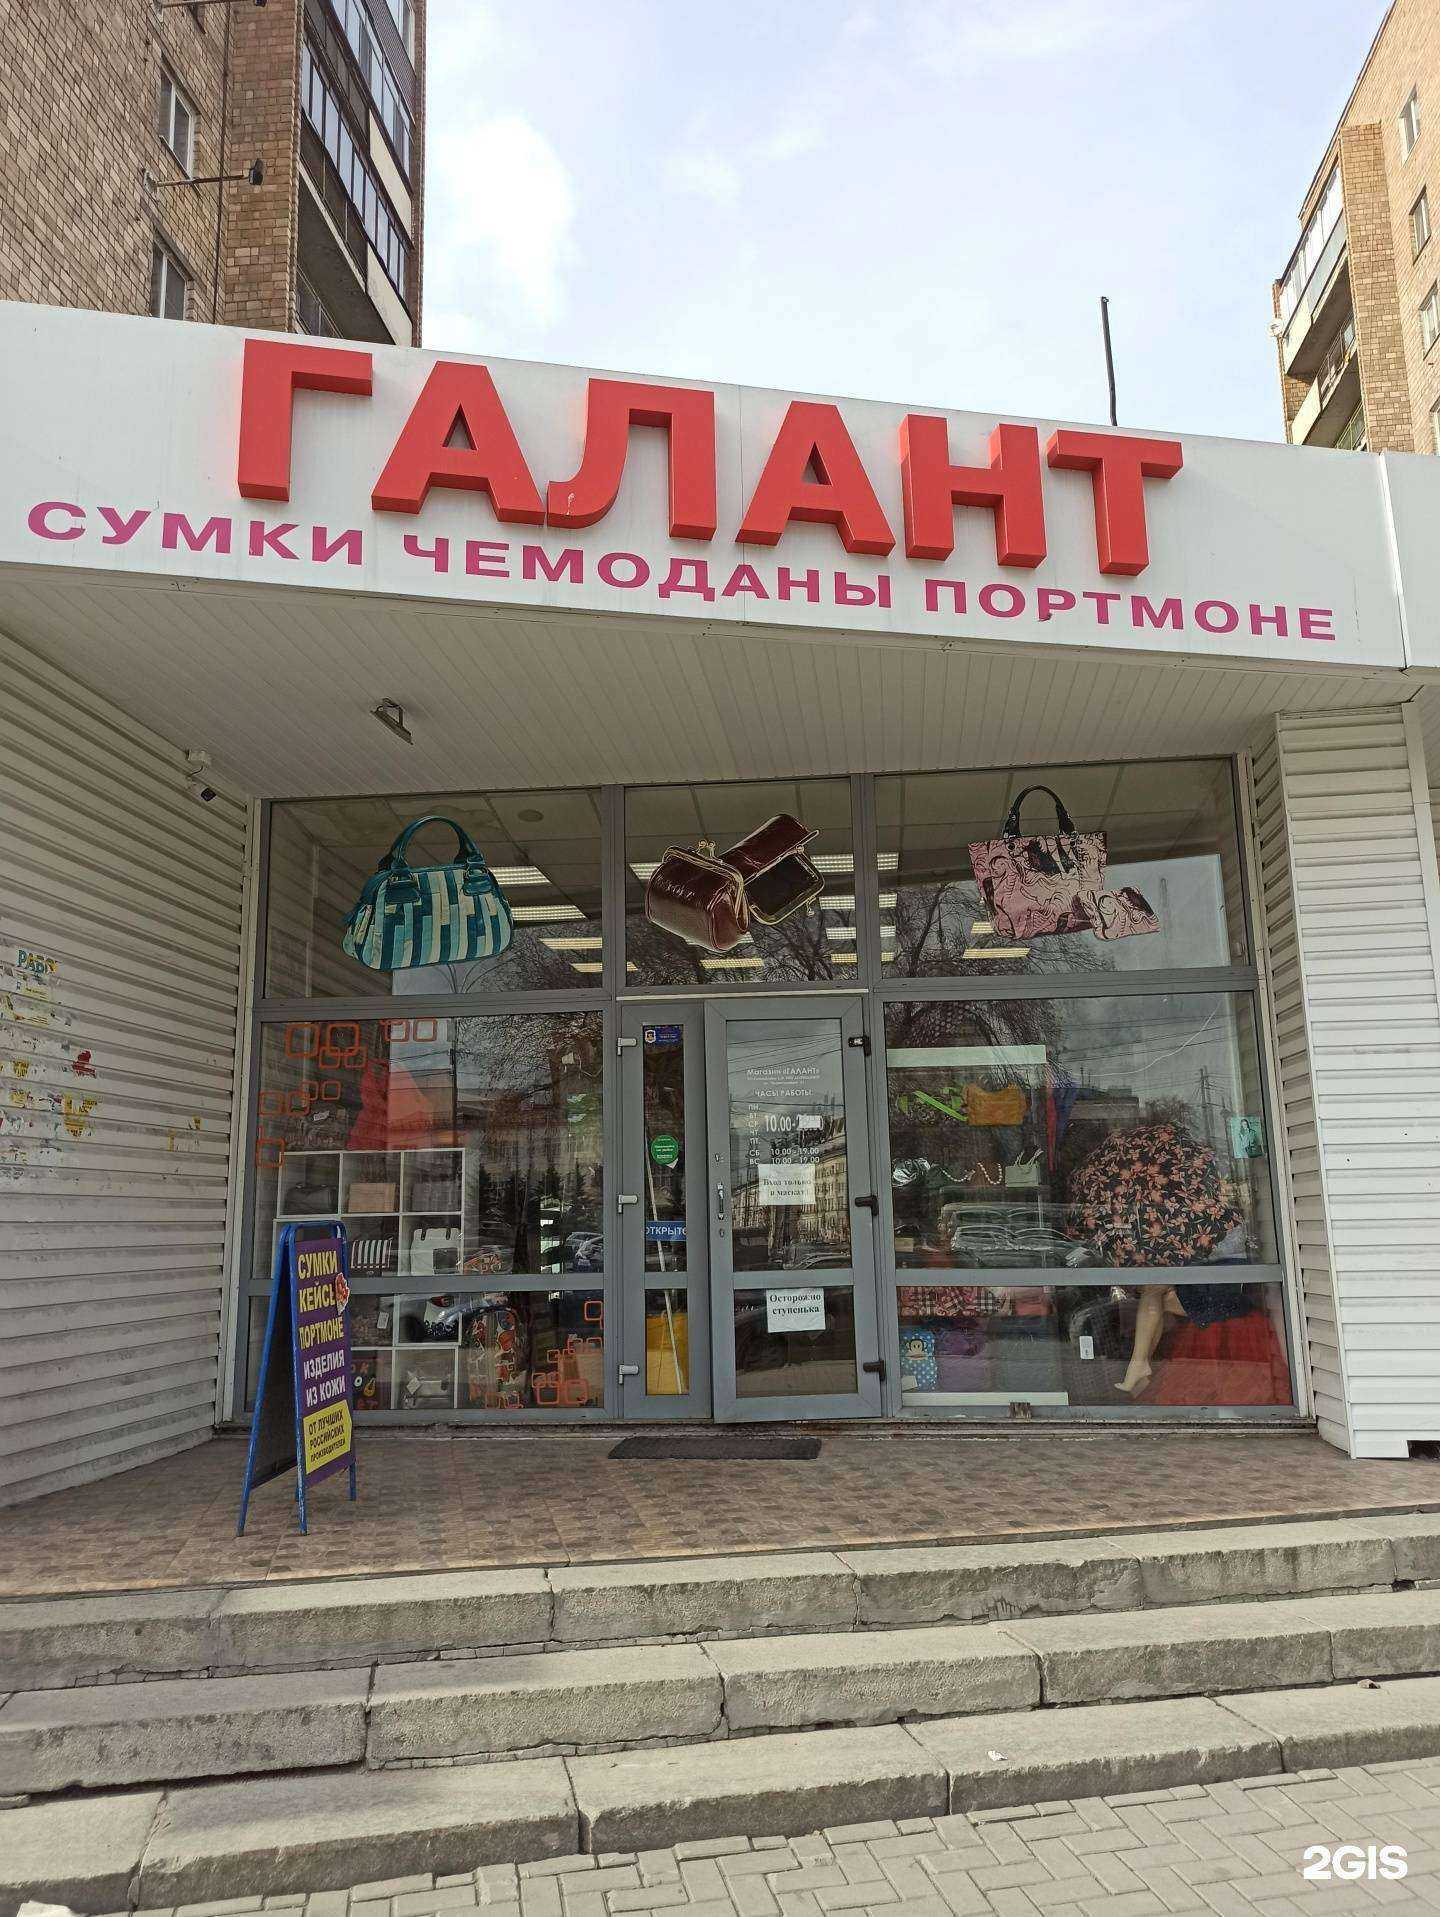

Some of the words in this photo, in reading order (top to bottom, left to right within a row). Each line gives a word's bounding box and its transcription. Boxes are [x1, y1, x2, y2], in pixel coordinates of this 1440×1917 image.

[238, 338, 1183, 576] ГАЛАНТ
[27, 501, 363, 566] СУМКИ
[403, 534, 892, 609] ЧЕМОДАНЫ
[924, 578, 1336, 641] ПОРТМОНЕ
[754, 1089, 779, 1097] ЧАСЫ
[298, 1250, 338, 1280] СУМКИ
[769, 1294, 821, 1303] Осторожно
[772, 1306, 820, 1316] ступенька
[299, 1316, 345, 1350] ПОРТМОНЕ
[303, 1349, 345, 1380] ИЗДЕЛИЯ
[306, 1386, 318, 1408] ИЗ
[320, 1375, 346, 1402] КОЖИ
[308, 1421, 317, 1436] ОТ
